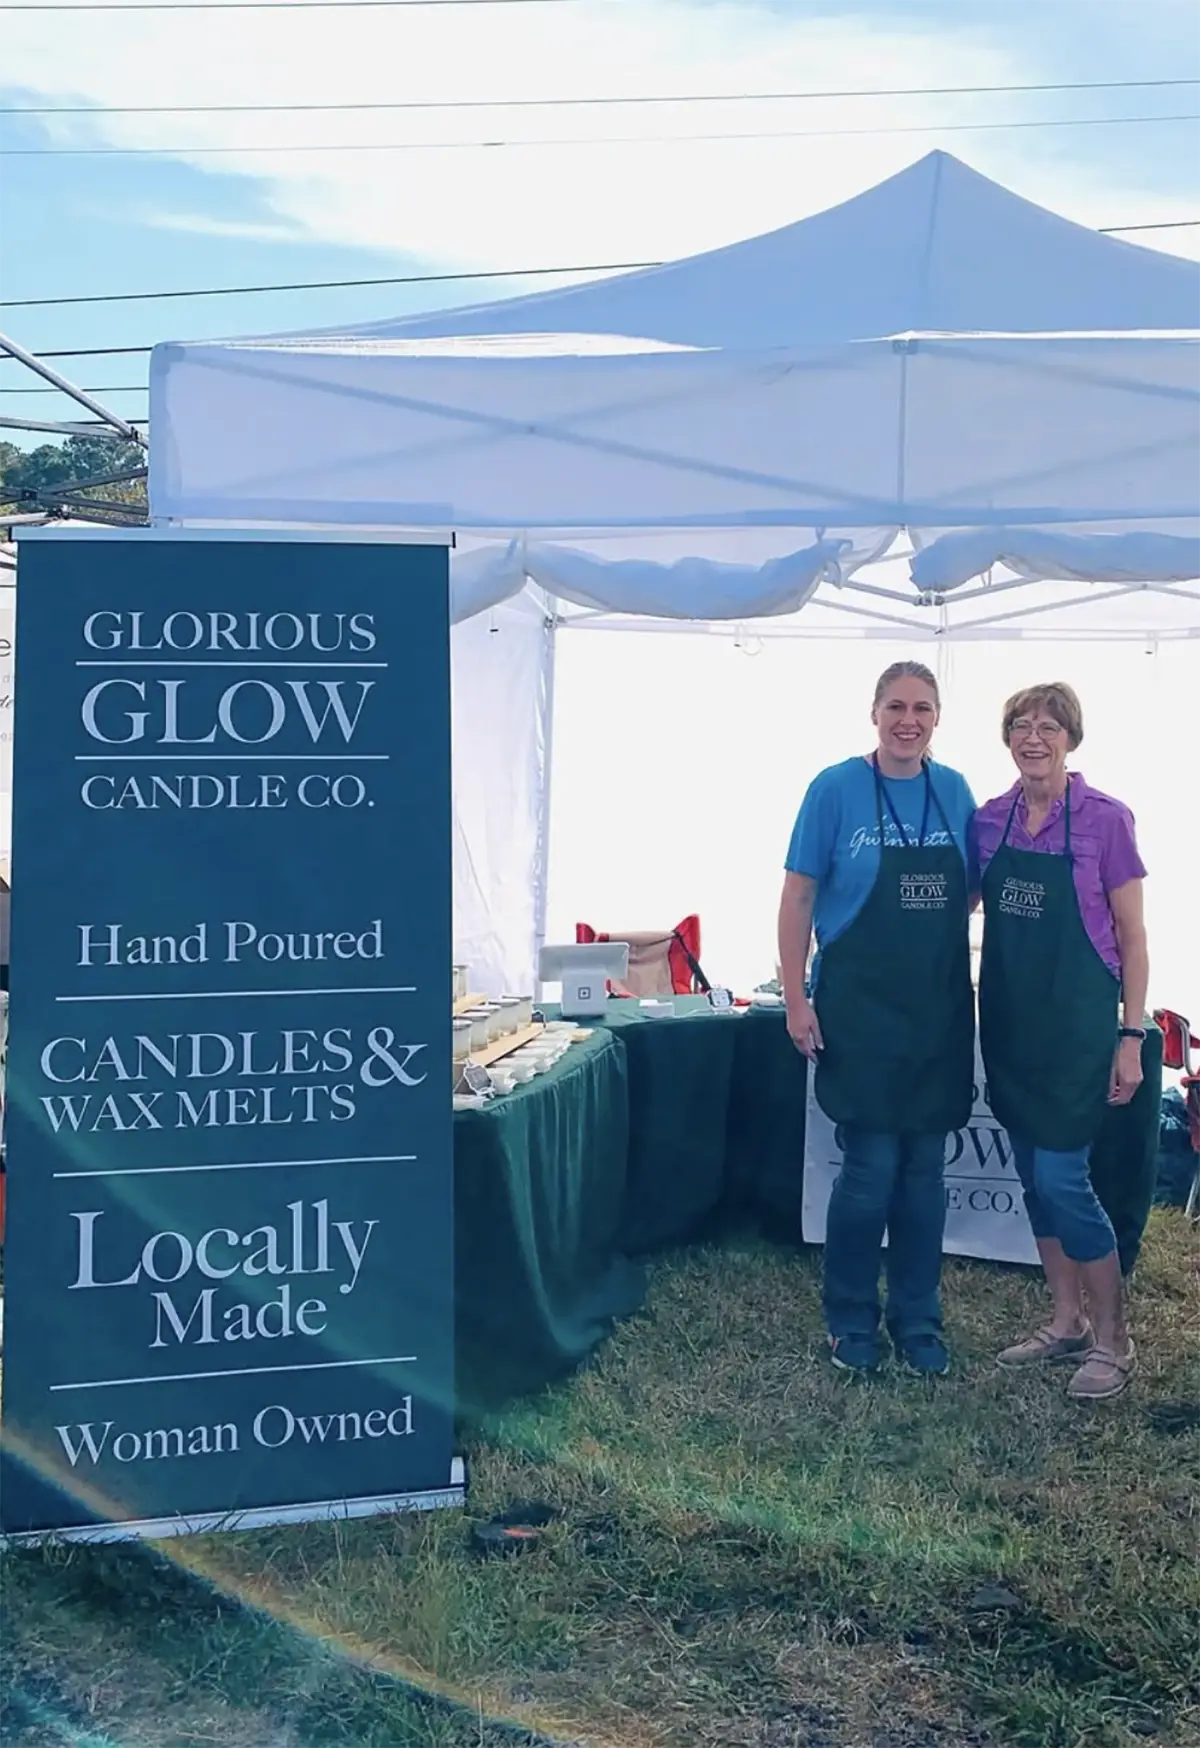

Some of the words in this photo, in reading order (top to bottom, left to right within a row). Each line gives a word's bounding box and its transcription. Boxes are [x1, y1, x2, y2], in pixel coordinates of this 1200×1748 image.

[83, 611, 376, 651] GLORIOUS
[81, 679, 376, 744] GLOW
[81, 776, 288, 809] CANDLE
[297, 775, 375, 808] CO.
[900, 885, 945, 898] GLOW
[1002, 889, 1043, 906] GLOW
[77, 923, 208, 966] Hand
[223, 919, 384, 962] Poured
[40, 1028, 353, 1084] CANDLES
[360, 1027, 427, 1087] &
[40, 1091, 162, 1133] WAX
[176, 1084, 355, 1128] MELTS
[968, 1188, 1019, 1216] CO.
[68, 1199, 379, 1294] Locally
[149, 1285, 327, 1348] Made
[56, 1420, 239, 1467] Woman
[254, 1396, 414, 1448] Owned
